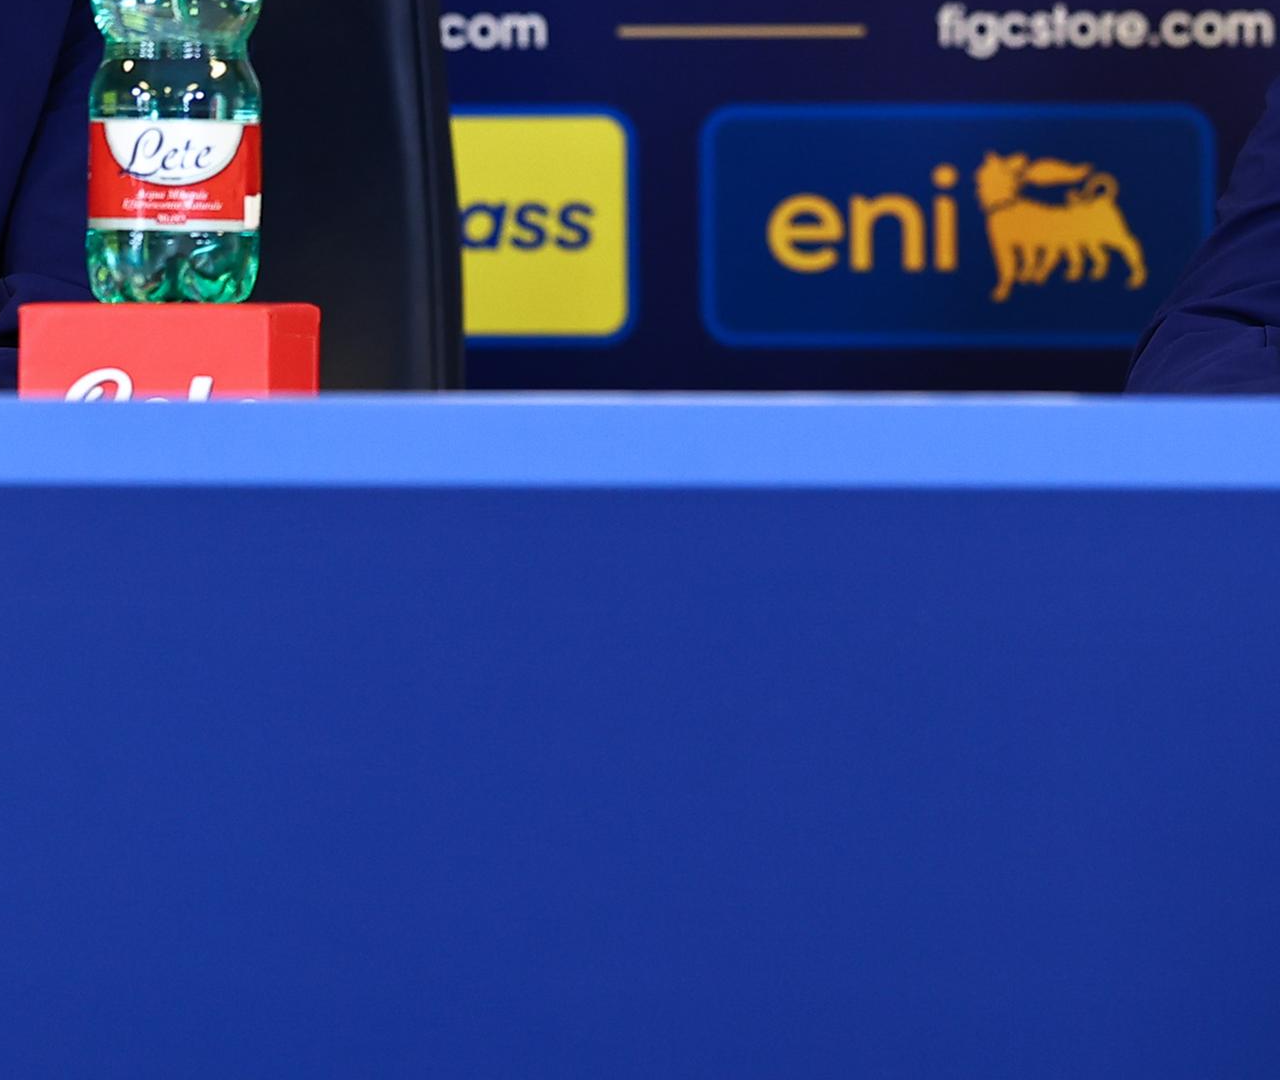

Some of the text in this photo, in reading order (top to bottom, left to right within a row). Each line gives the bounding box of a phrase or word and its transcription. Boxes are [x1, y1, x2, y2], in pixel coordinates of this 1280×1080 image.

[936, 3, 1275, 60] figcstore.com
[118, 127, 212, 178] Lete
[766, 163, 958, 273] eni
